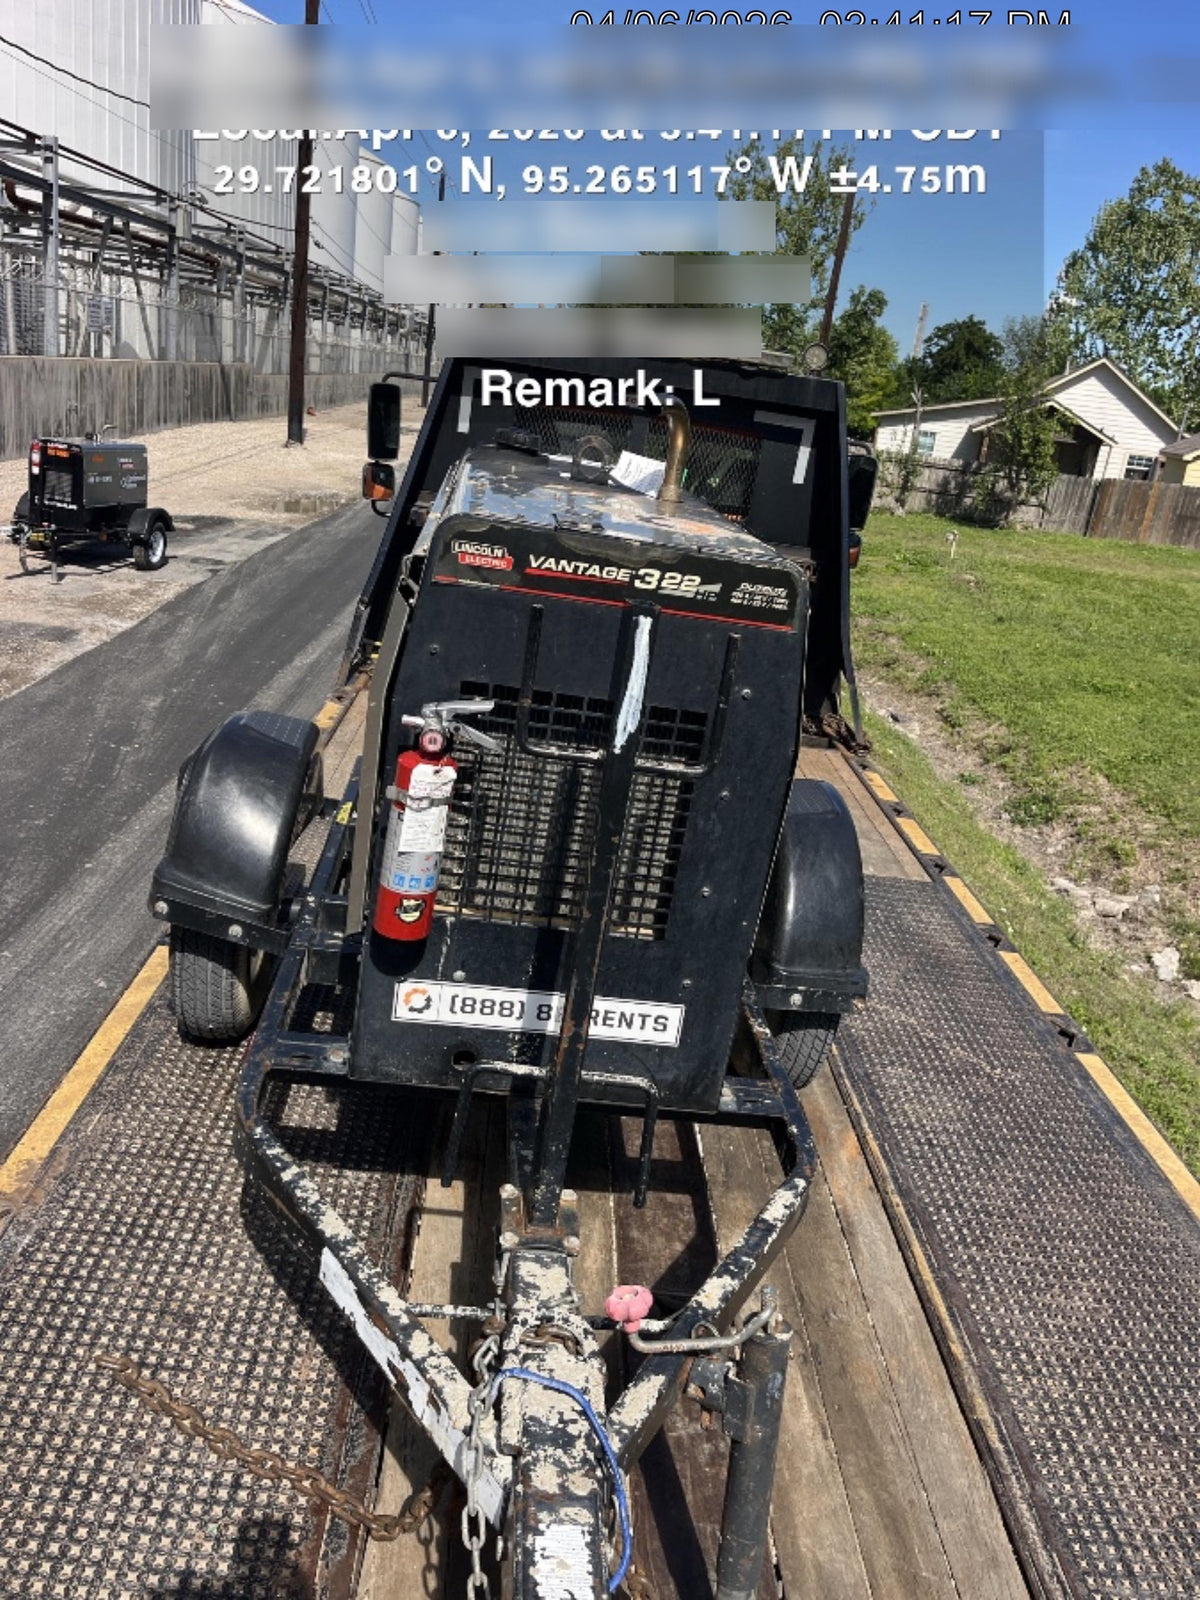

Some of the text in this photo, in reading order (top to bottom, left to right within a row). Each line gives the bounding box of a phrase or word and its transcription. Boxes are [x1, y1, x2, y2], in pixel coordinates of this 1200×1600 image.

[454, 541, 505, 557] LINCOLN
[463, 555, 509, 569] ELECTRIC
[529, 553, 702, 593] VANTAGE 322
[449, 994, 526, 1020] (888)
